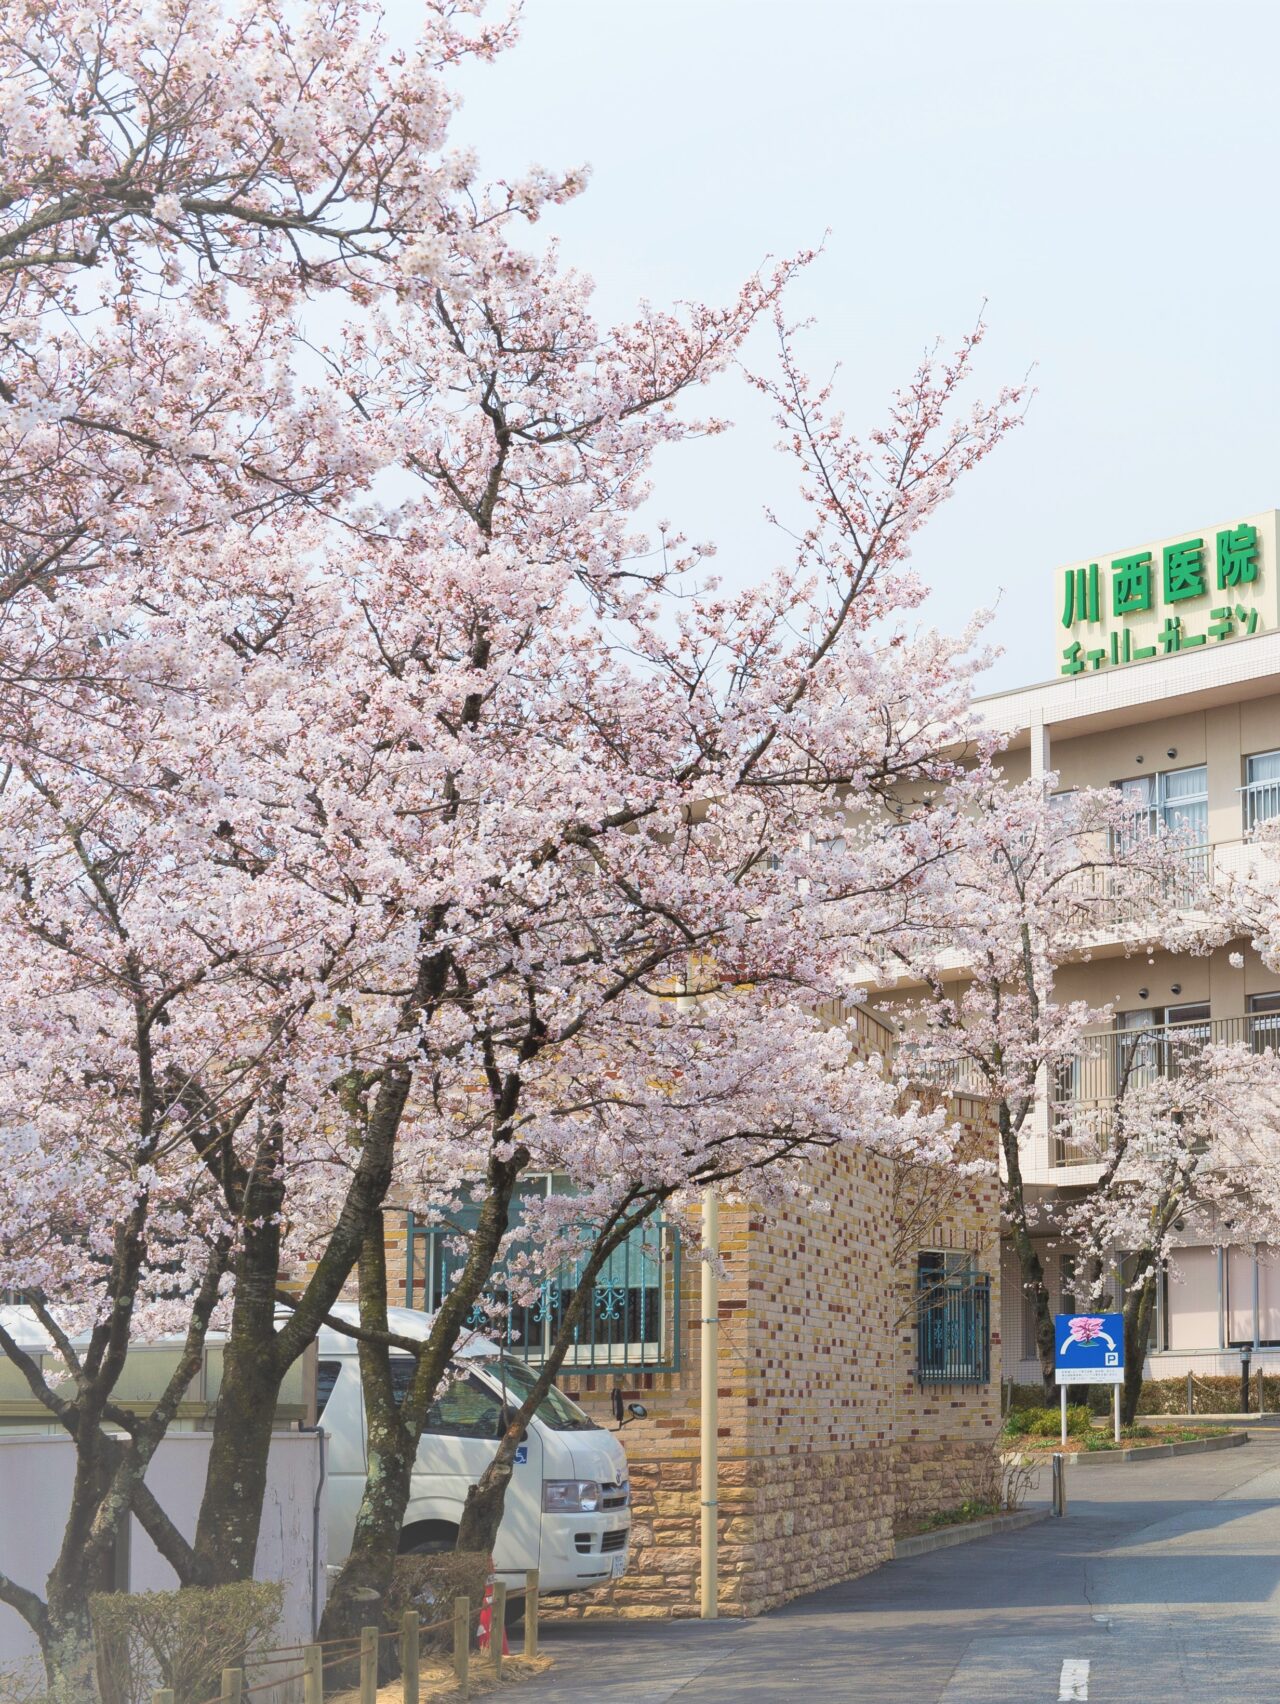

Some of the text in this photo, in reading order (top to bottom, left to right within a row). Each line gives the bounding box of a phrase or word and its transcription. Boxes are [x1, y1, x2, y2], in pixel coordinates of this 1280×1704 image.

[1062, 523, 1258, 629] 川西医院
[1107, 1355, 1116, 1364] P
